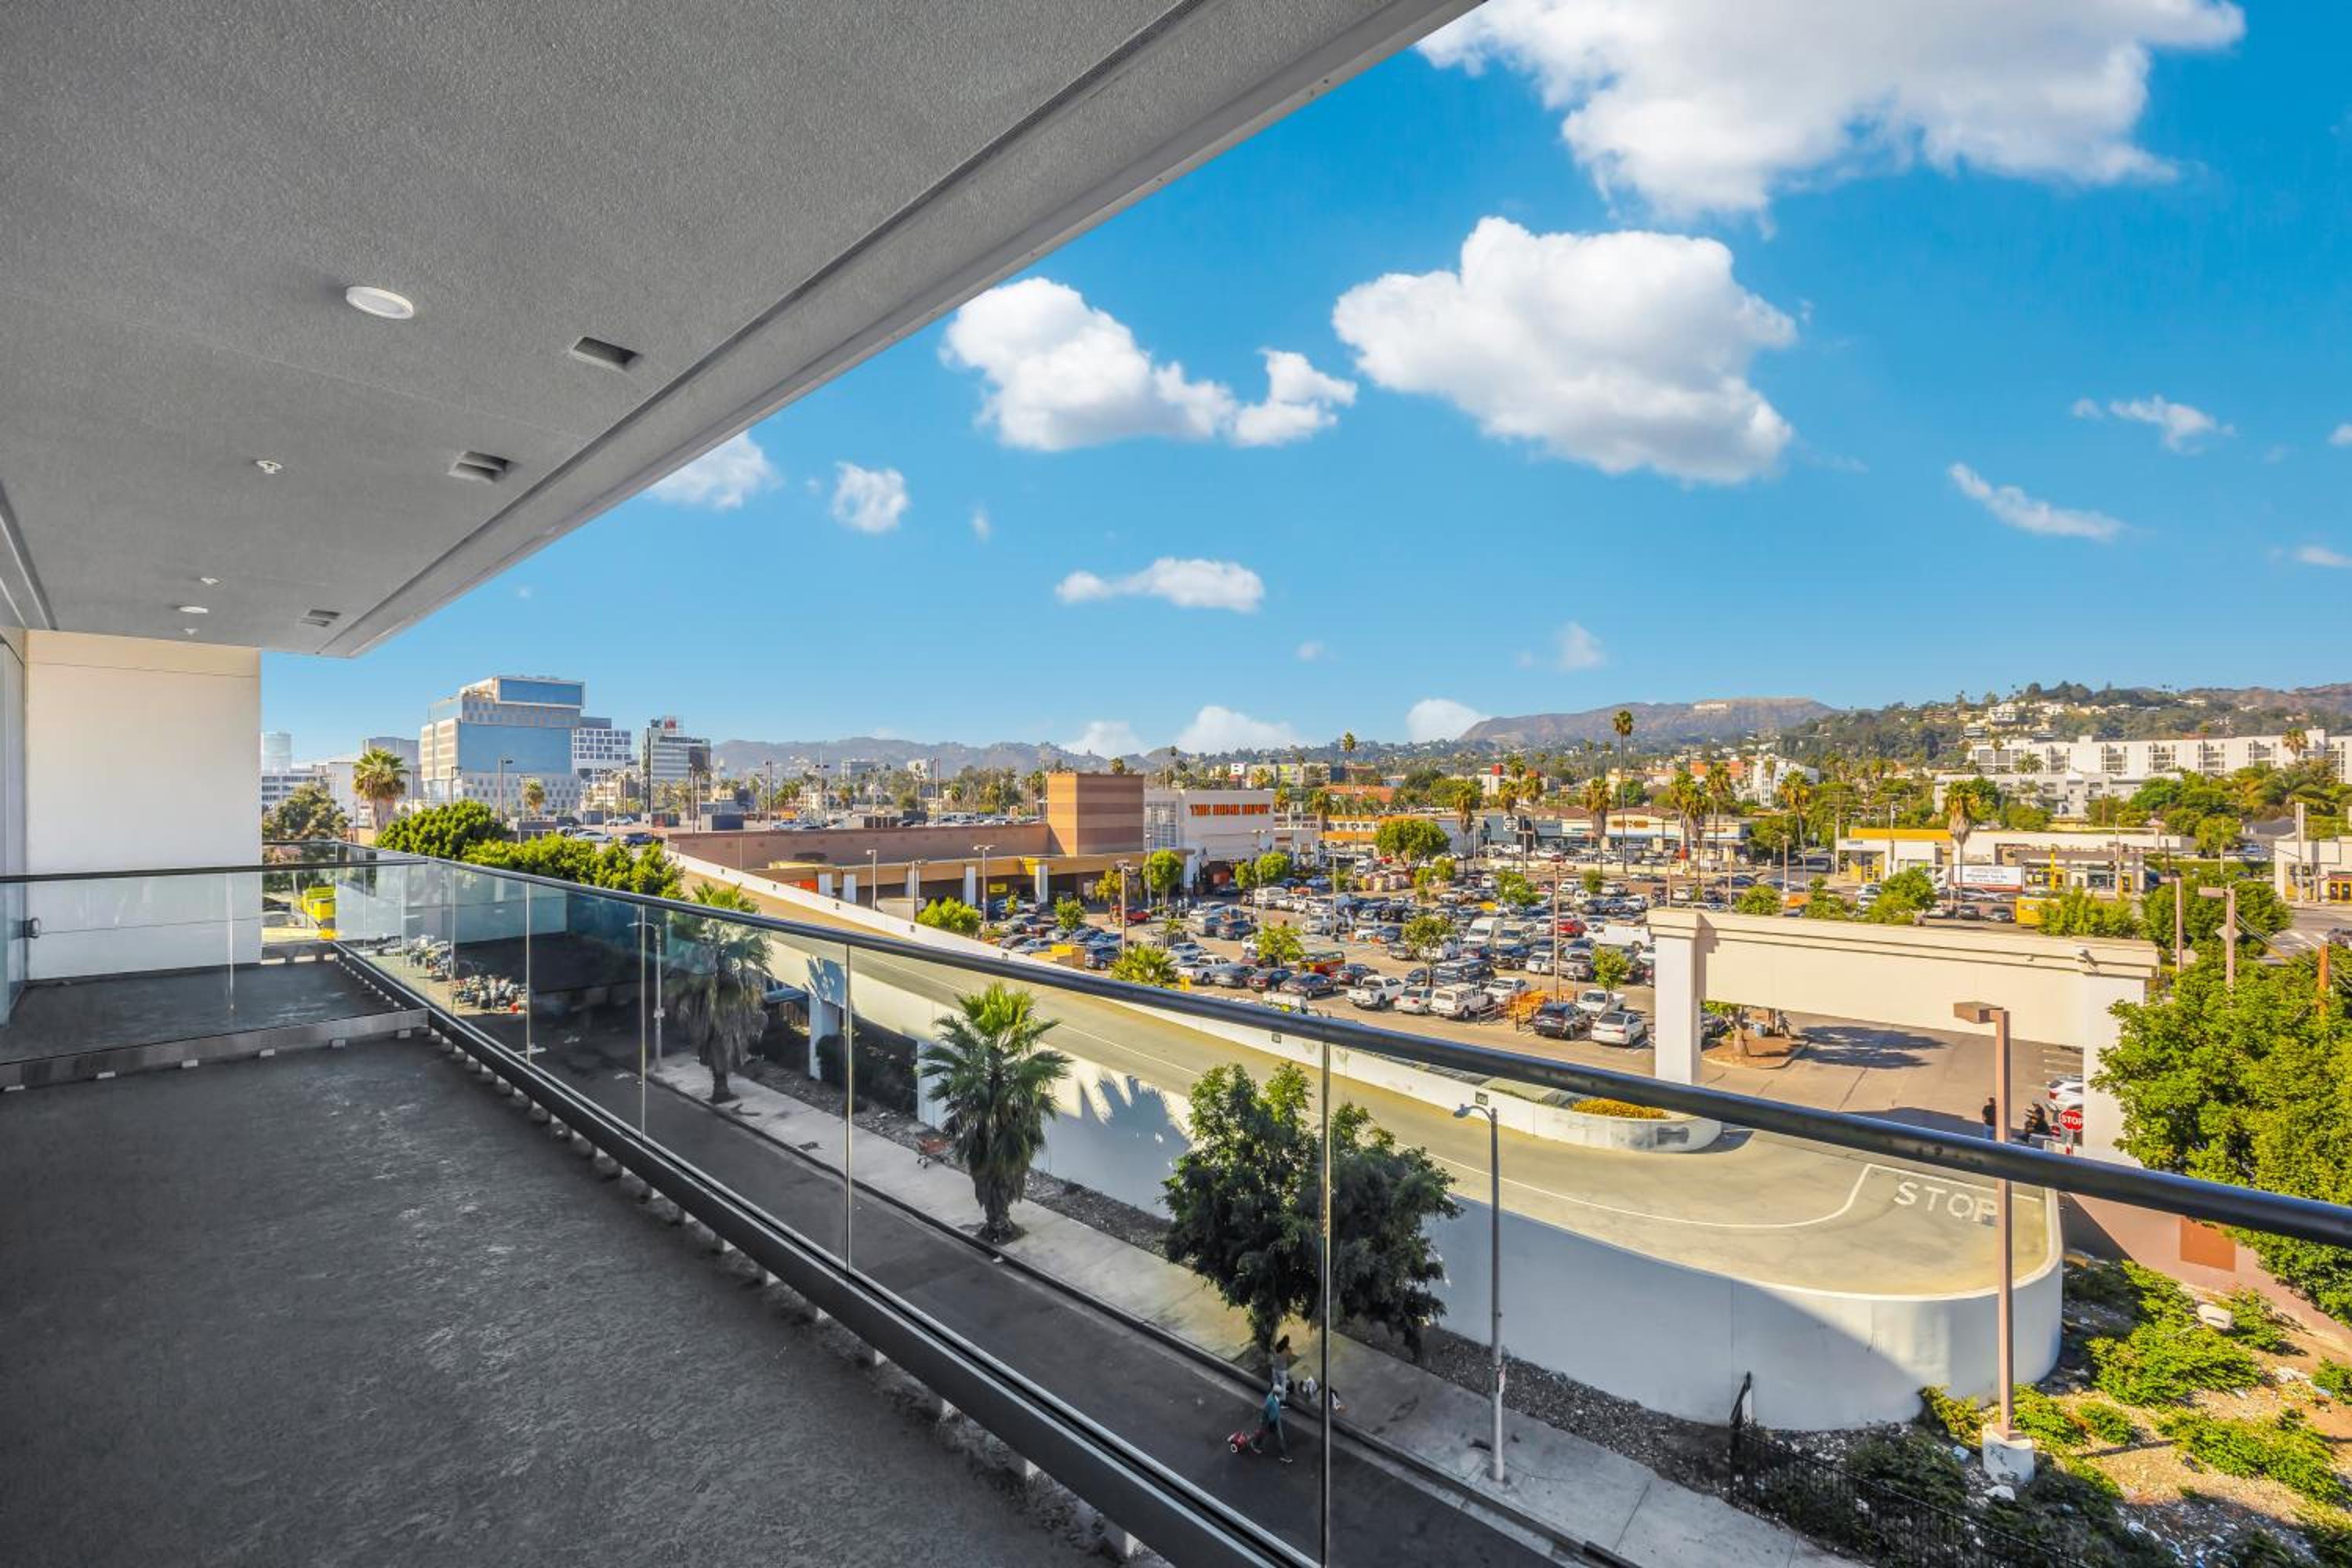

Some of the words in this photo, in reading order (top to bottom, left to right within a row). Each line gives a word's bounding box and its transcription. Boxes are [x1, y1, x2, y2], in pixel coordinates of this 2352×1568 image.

[1189, 804, 1210, 816] THE
[1213, 804, 1240, 816] HOME
[1241, 804, 1271, 815] DEPOT
[2061, 1114, 2083, 1127] STOP
[1893, 1181, 1998, 1222] STOP
